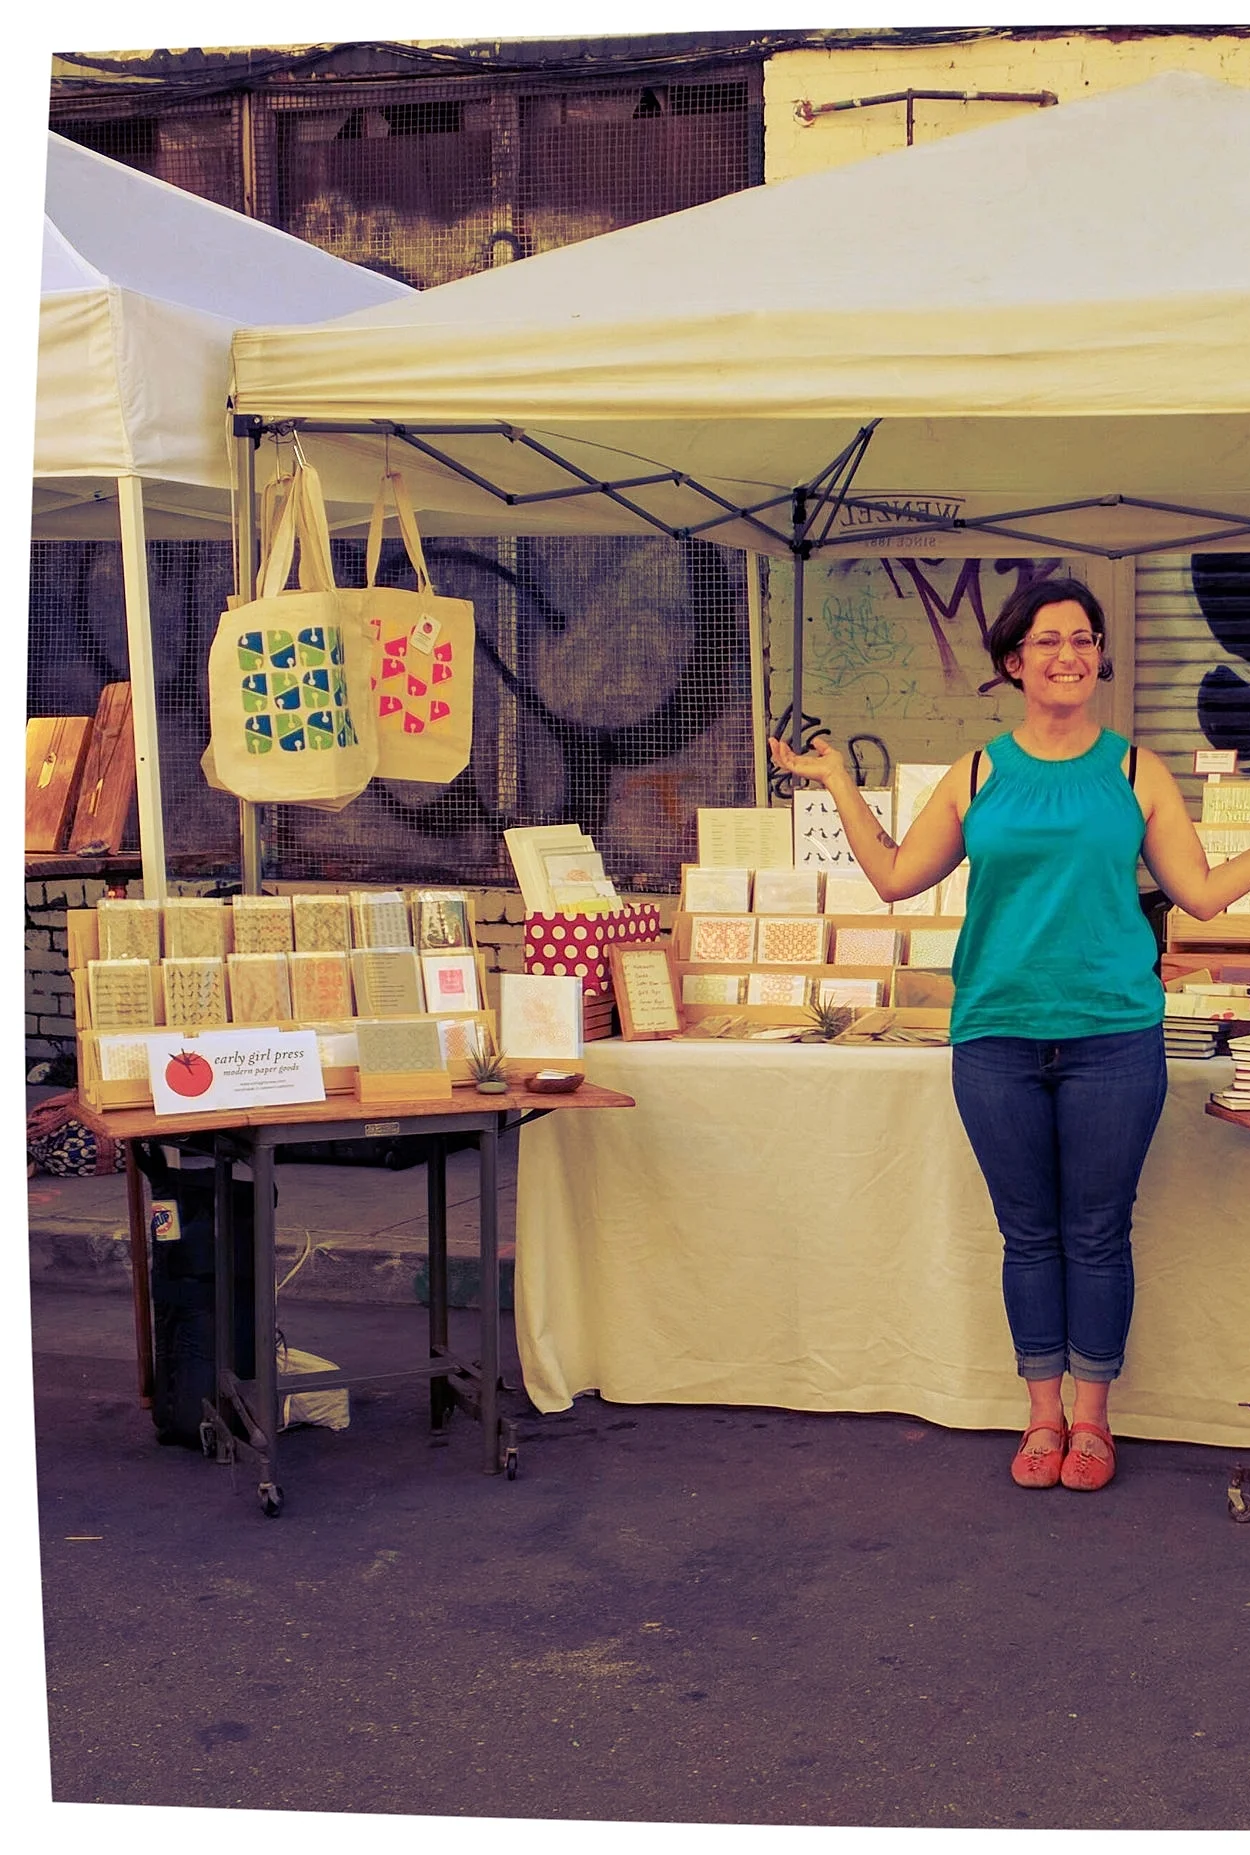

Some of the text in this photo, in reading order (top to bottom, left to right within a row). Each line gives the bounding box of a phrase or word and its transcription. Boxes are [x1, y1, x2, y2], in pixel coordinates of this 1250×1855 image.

[214, 1048, 305, 1067] early girl press
[223, 1063, 300, 1076] modern paper goods
